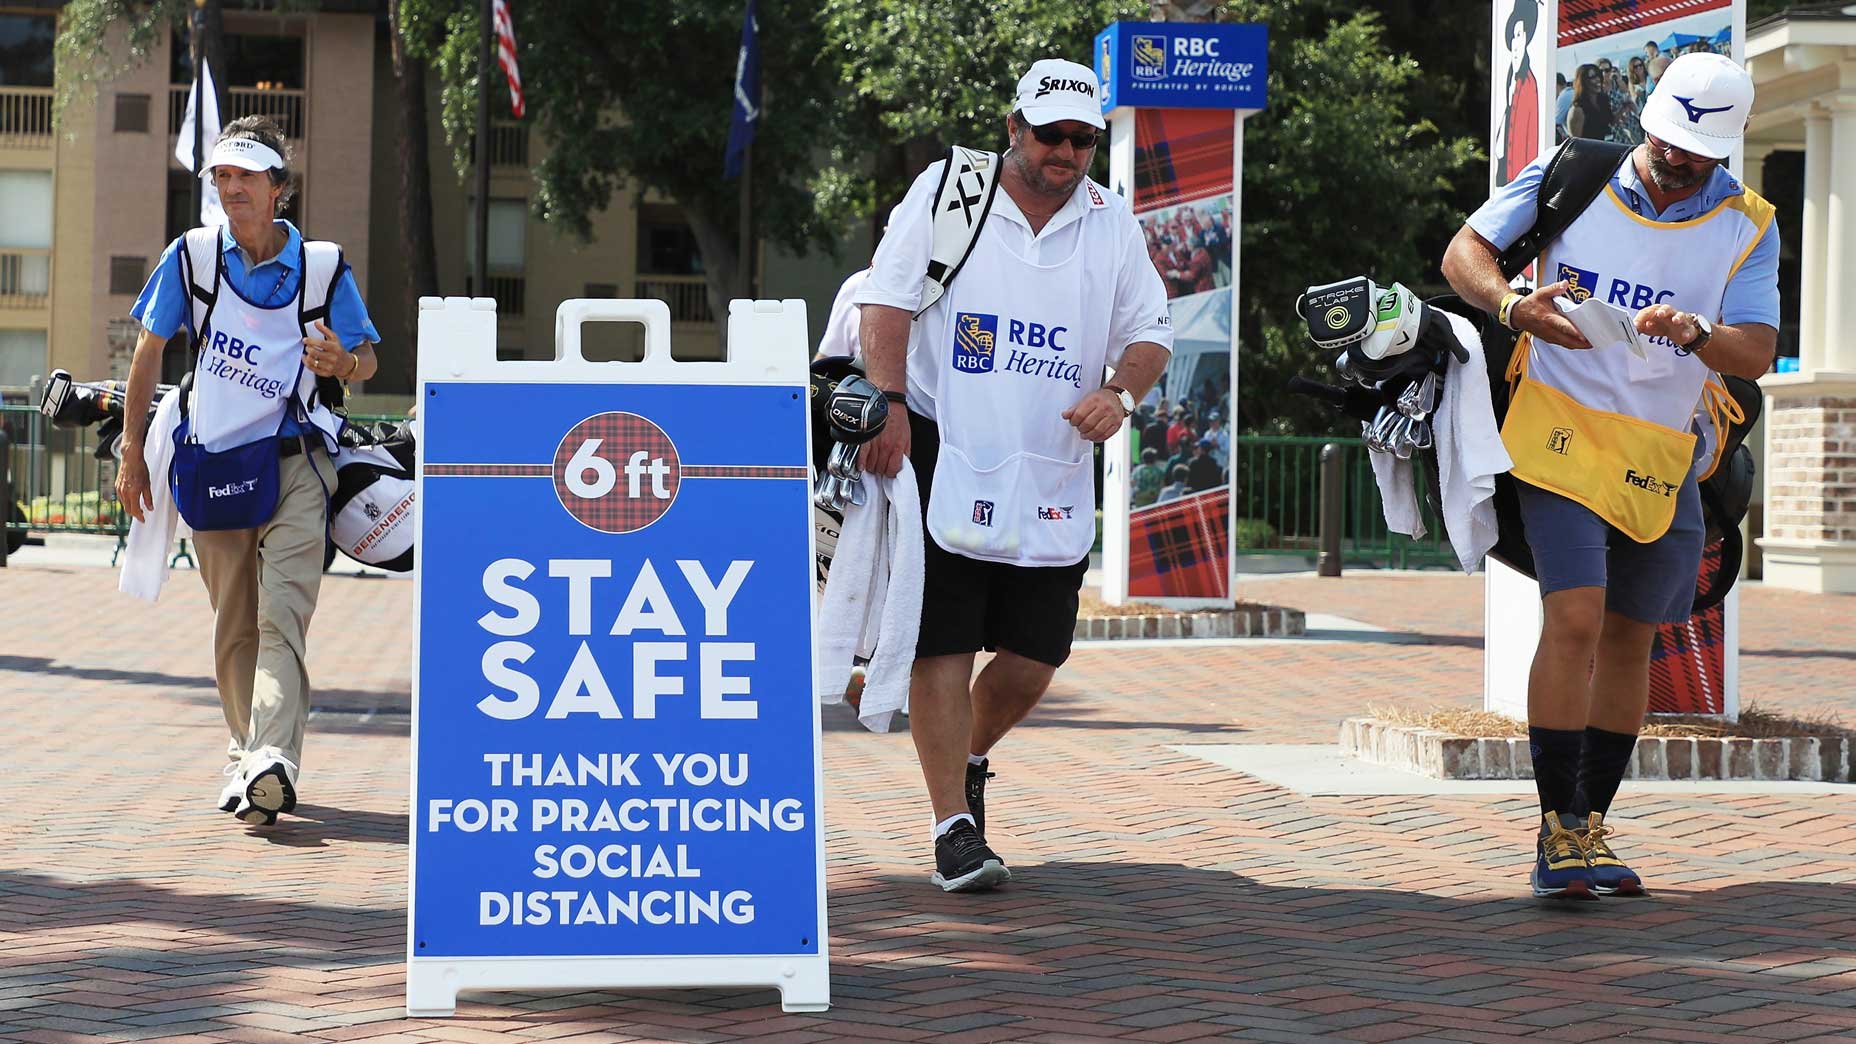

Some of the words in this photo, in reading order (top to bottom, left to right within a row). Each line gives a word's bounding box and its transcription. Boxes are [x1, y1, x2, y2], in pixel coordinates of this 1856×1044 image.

[1174, 37, 1220, 57] RBC
[1135, 66, 1162, 77] RBC
[1173, 58, 1254, 82] Heritage
[1035, 76, 1095, 99] SRIXON
[1308, 285, 1365, 306] STROKE
[1323, 295, 1349, 307] LAB
[211, 330, 262, 367] RBC
[1008, 318, 1068, 352] RBC
[957, 355, 990, 370] RBC
[1004, 348, 1083, 389] Herita
[564, 438, 617, 499] 6
[624, 450, 671, 499] ft
[1624, 469, 1661, 495] FedEx
[1037, 505, 1063, 521] FedEx
[477, 557, 755, 637] STAY
[476, 639, 758, 721] SAFE
[484, 753, 642, 787] THANK
[652, 752, 749, 787] YOU
[428, 798, 519, 833] FOR
[532, 798, 805, 833] PRACTICING
[532, 844, 701, 879] SOCIAL
[479, 890, 755, 926] DISTANCING
